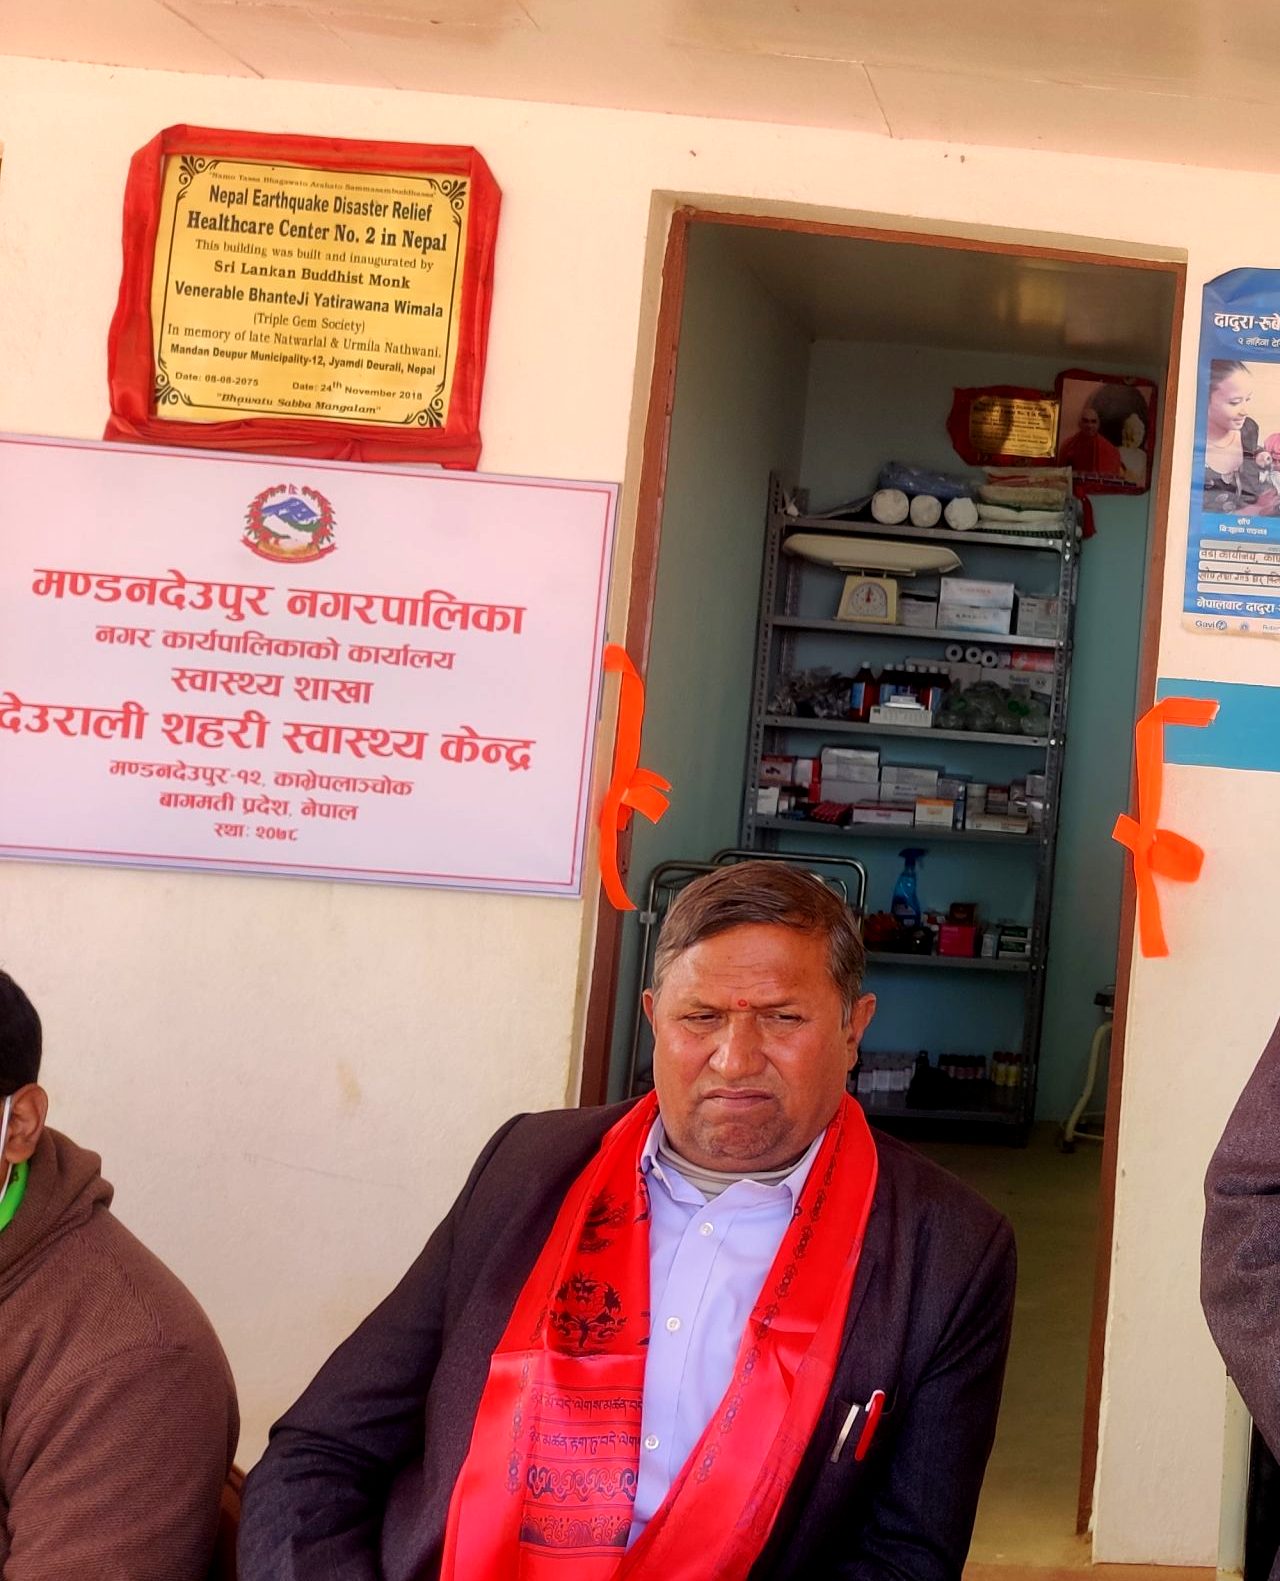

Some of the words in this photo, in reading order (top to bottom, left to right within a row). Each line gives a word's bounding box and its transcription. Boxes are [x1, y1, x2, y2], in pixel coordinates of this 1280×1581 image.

[209, 184, 248, 208] Nepal
[252, 188, 329, 214] Earthquake
[333, 195, 389, 218] Disaster
[392, 201, 432, 222] Relief
[187, 210, 274, 236] Healthcare
[279, 219, 330, 240] Center
[334, 224, 359, 243] No.
[365, 226, 376, 244] 2
[381, 228, 397, 246] in
[402, 229, 447, 255] Nepal
[195, 239, 219, 251] This
[223, 241, 268, 258] building
[272, 247, 293, 257] was
[297, 247, 321, 260] built
[325, 251, 346, 263] and
[350, 252, 416, 269] inaugurated
[420, 258, 434, 272] by
[214, 260, 235, 273] Sri
[241, 262, 296, 279] Lankan
[301, 268, 364, 285] Buddhist
[369, 274, 411, 289] Monk
[175, 281, 244, 301] Venerable
[249, 287, 309, 307] BhanteJi
[314, 293, 389, 313] Yatirawana
[394, 300, 443, 318] Wimala
[253, 312, 289, 328] (Triple
[292, 315, 317, 328] Gem
[321, 317, 365, 334] Society)
[168, 323, 179, 335] In
[184, 326, 230, 343] memory
[234, 329, 246, 341] of
[249, 330, 270, 344] late
[274, 333, 327, 348] Natwarlal
[330, 337, 339, 349] &
[343, 338, 380, 353] Urmila
[384, 341, 442, 358] Nathwani.
[170, 343, 210, 356] Mandan
[212, 347, 248, 361] Deupur
[250, 350, 326, 367] Municipality-12,
[328, 356, 364, 369] Jyamdi
[366, 359, 404, 374] Deurali,
[407, 363, 436, 377] Nepal
[175, 372, 201, 382] Date:
[292, 382, 317, 392] Date:
[320, 381, 342, 393] 24th
[344, 387, 396, 398] November
[399, 391, 423, 401] 2018
[277, 397, 312, 409] Sabba
[31, 568, 275, 622] मण्डनदेउपुर
[287, 588, 528, 635] नगरपालिका
[1195, 620, 1215, 629] Gavi
[95, 625, 156, 649] नगर
[162, 629, 341, 661] कार्यपालिकाको
[347, 644, 457, 670] कार्यालय
[171, 667, 285, 697] स्वास्थ्य
[294, 675, 375, 705] शाखा
[0, 691, 149, 740] देउराली
[162, 710, 271, 749] शहरी
[283, 722, 429, 761] स्वास्थ्य
[440, 725, 537, 772] केन्द्र
[300, 797, 359, 821] नेपाल
[255, 825, 298, 842] २०७८
